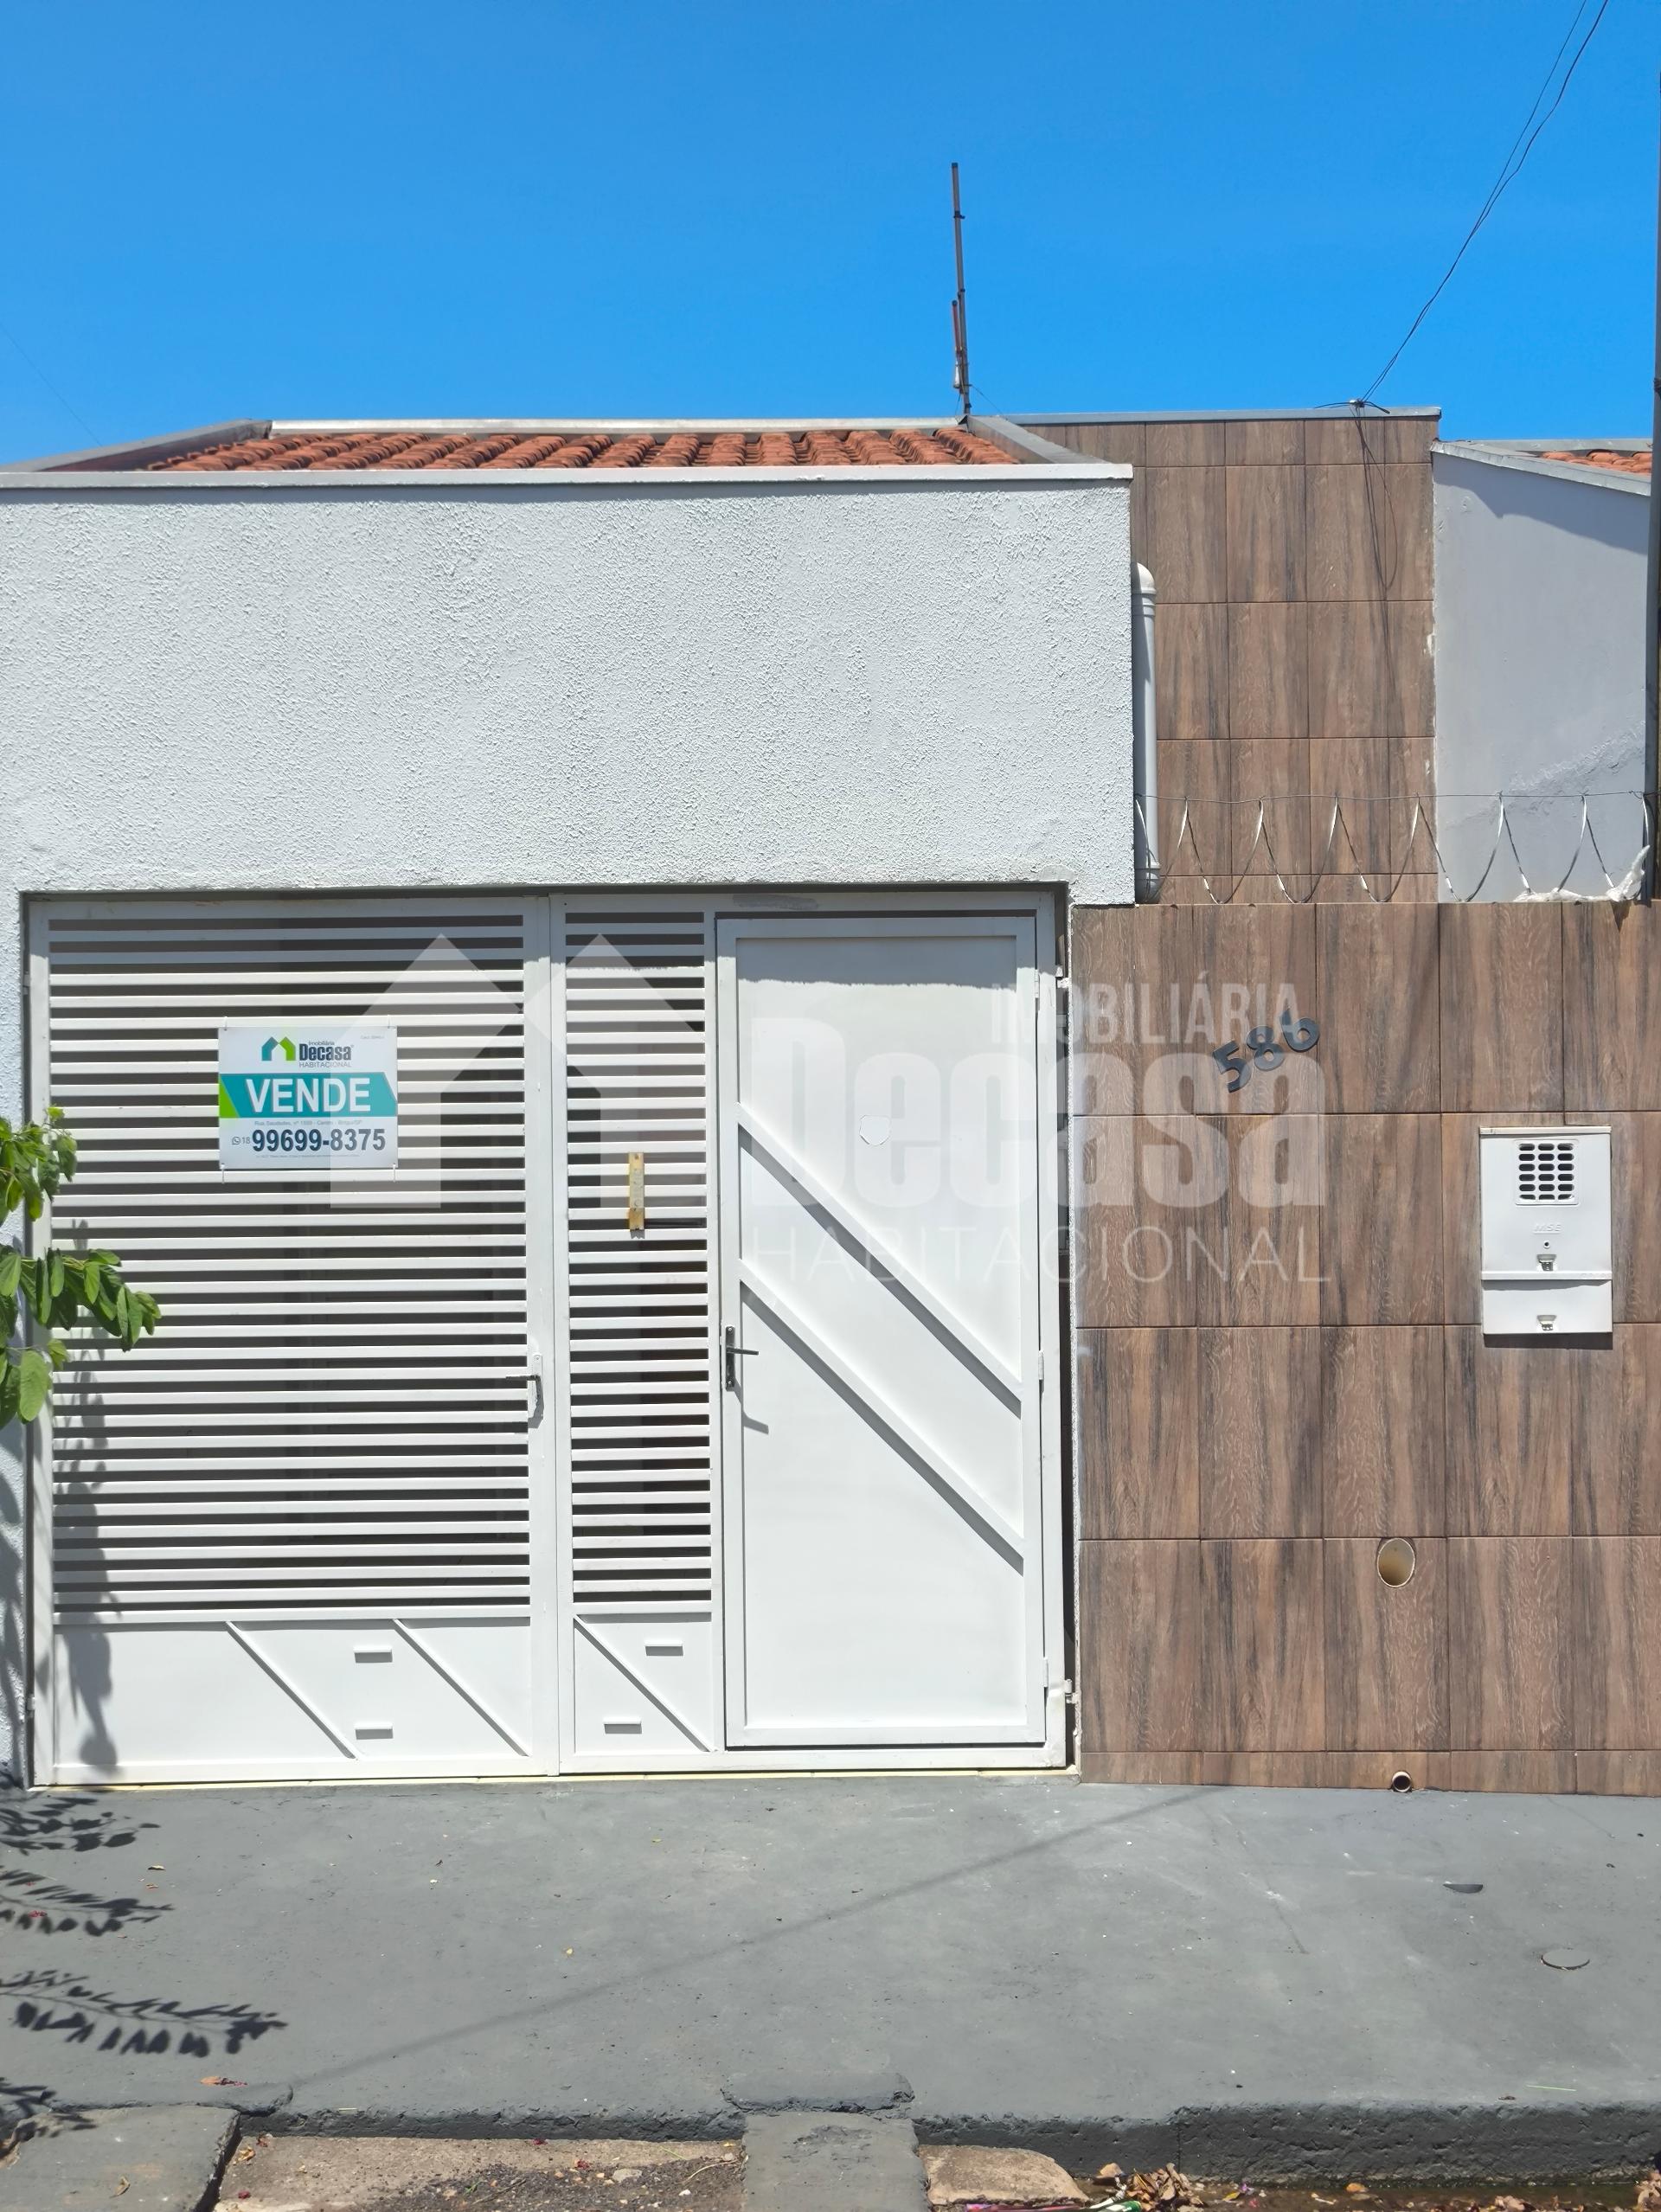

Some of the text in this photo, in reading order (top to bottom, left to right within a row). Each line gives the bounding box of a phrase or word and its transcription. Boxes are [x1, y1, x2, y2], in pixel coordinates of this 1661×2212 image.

[298, 1043, 352, 1061] Decasa
[1212, 1008, 1320, 1093] 586
[246, 1078, 371, 1113] VENDE
[252, 1128, 386, 1152] 99699-8375
